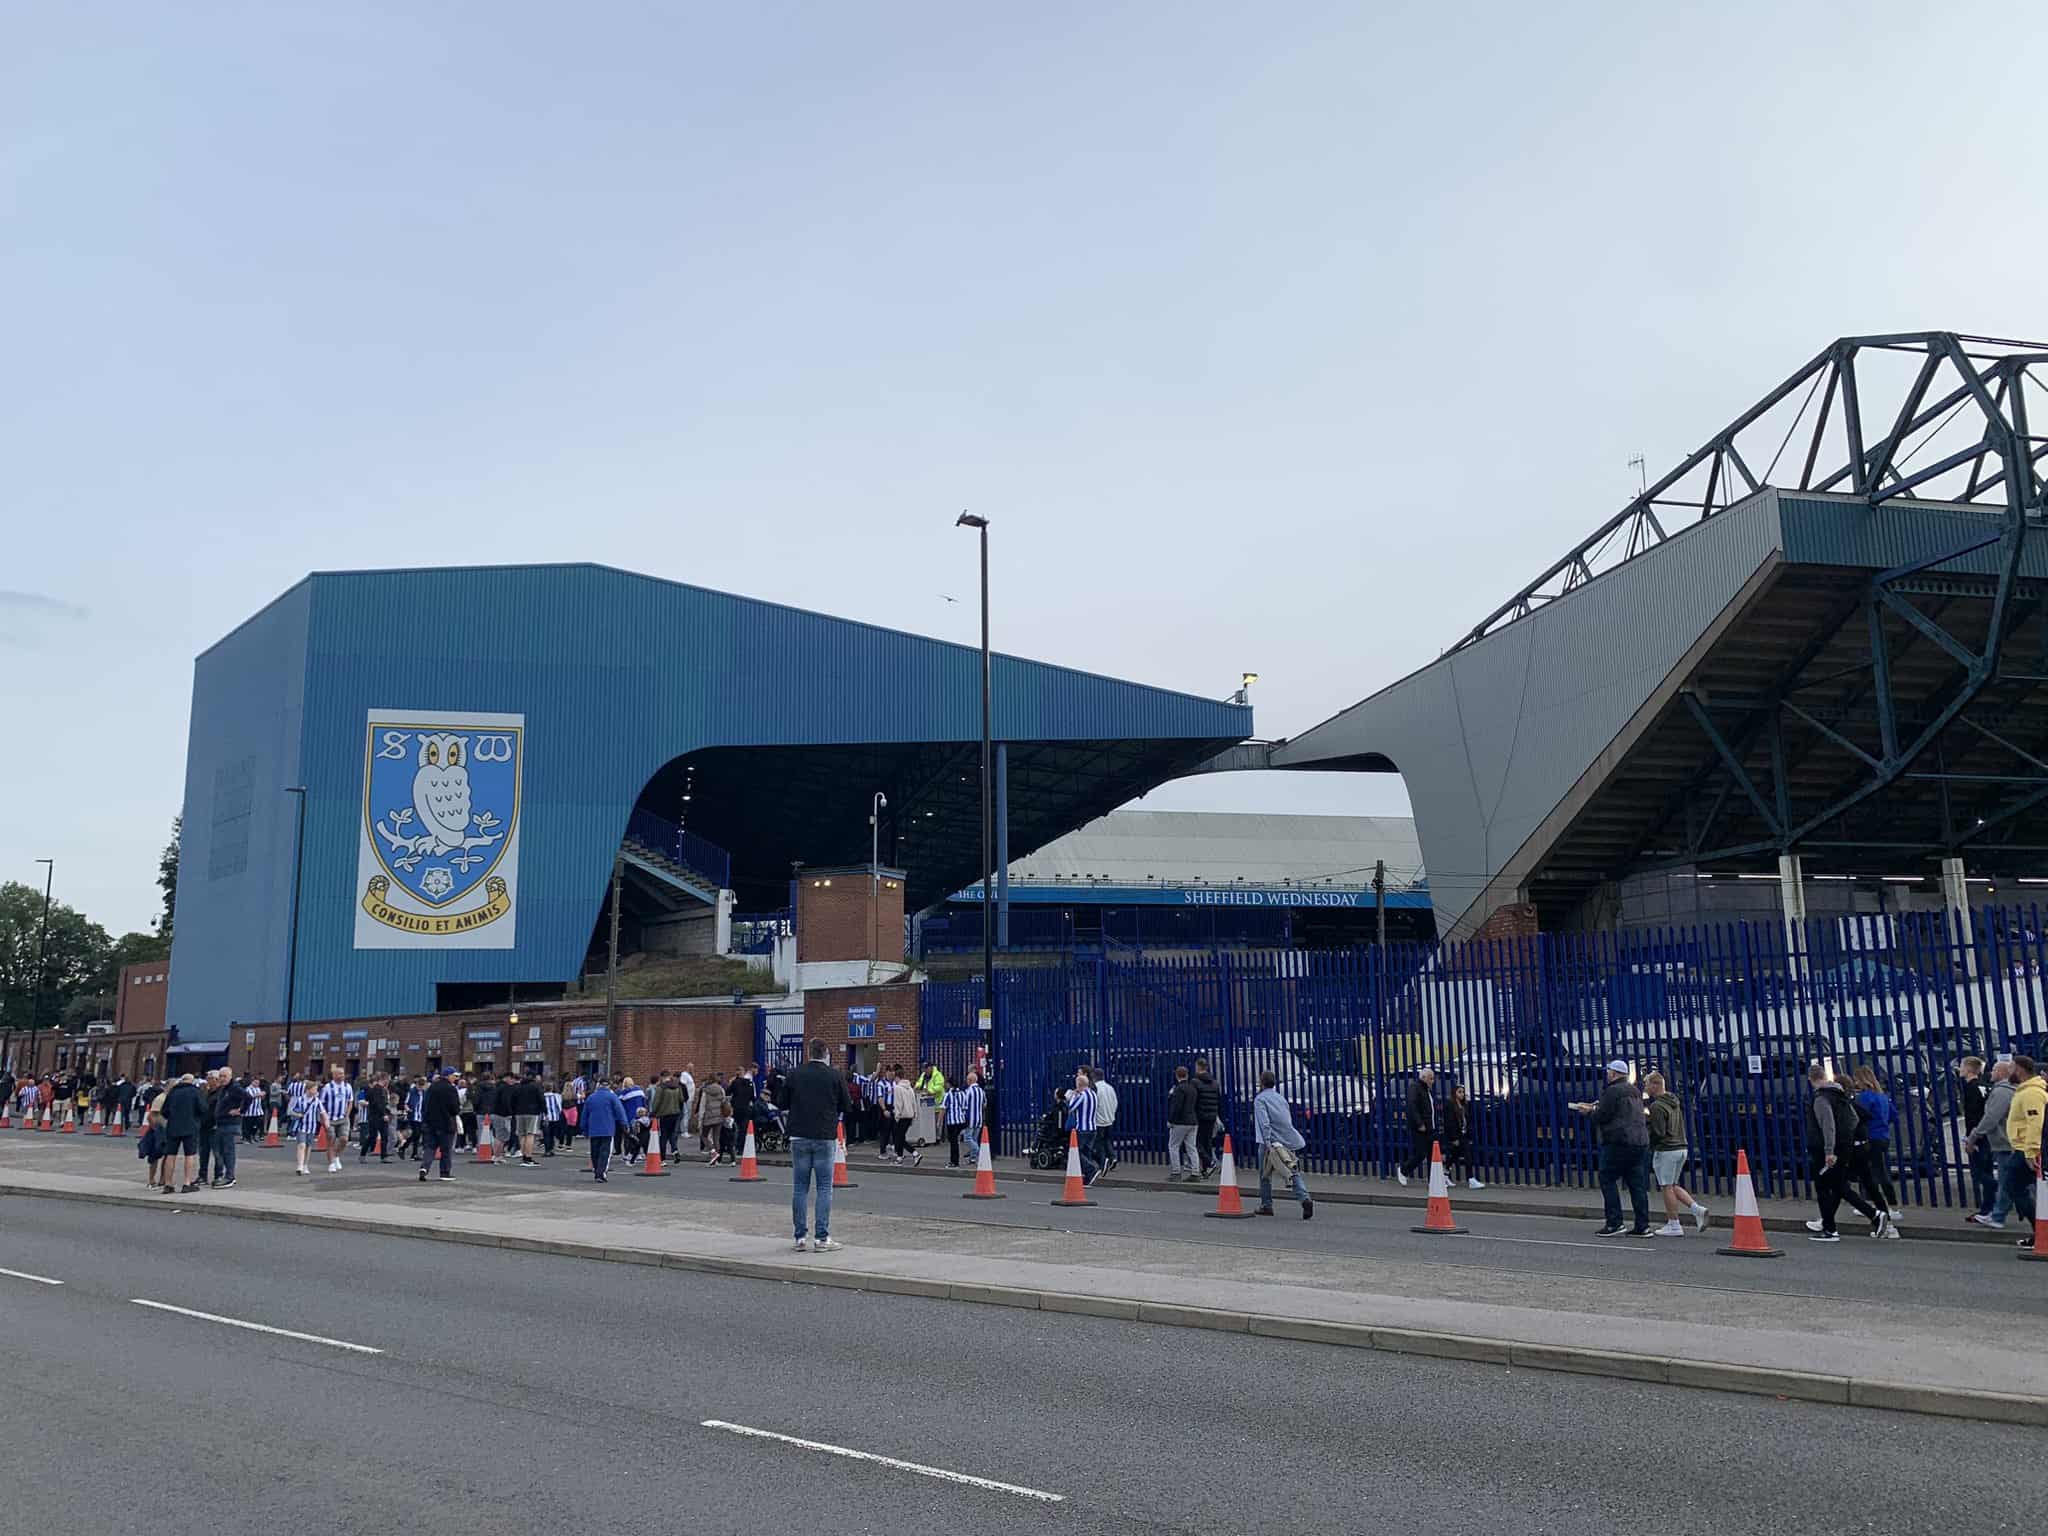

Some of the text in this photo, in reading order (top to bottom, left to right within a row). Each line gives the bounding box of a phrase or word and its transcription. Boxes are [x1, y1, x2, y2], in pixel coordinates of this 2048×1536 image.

[376, 731, 411, 759] S
[1184, 890, 1359, 906] SHEFFIELD WEDNESDAY
[371, 903, 501, 931] CONSILIO ET ANIMIS
